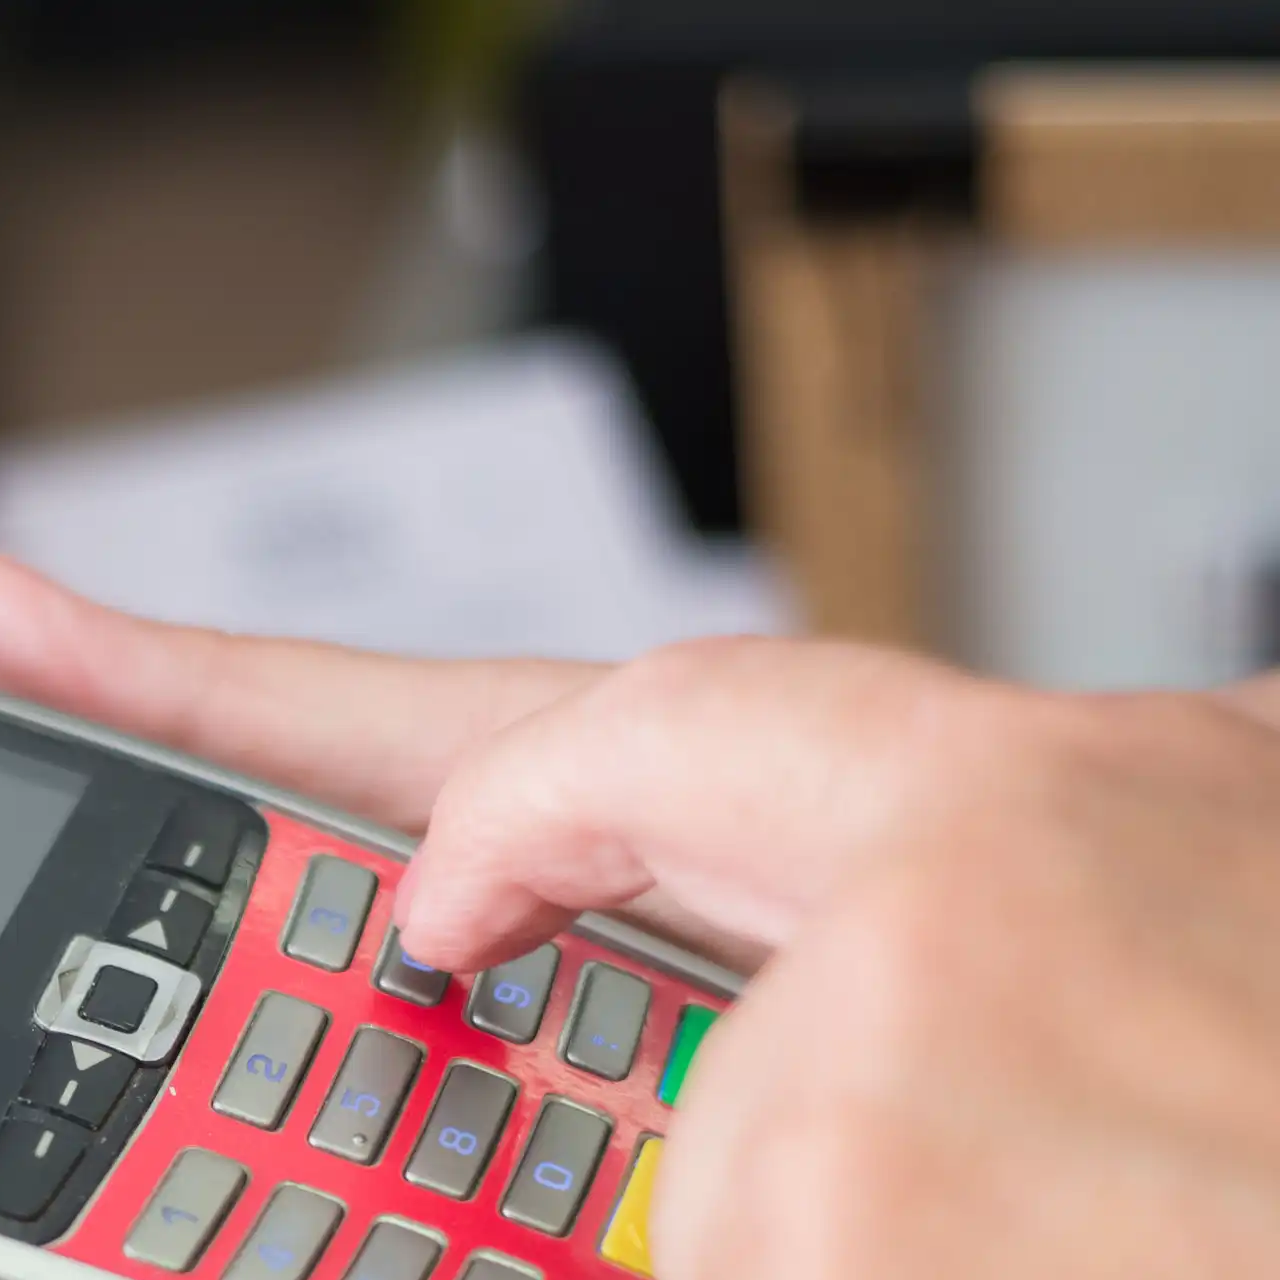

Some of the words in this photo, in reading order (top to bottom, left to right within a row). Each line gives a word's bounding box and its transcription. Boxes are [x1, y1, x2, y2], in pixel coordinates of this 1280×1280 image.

[309, 906, 349, 935] 3
[493, 981, 531, 1009] 9
[246, 1053, 288, 1083] 2
[340, 1087, 381, 1117] 5
[438, 1127, 476, 1155] 8
[534, 1162, 573, 1190] 0
[161, 1205, 199, 1224] 1
